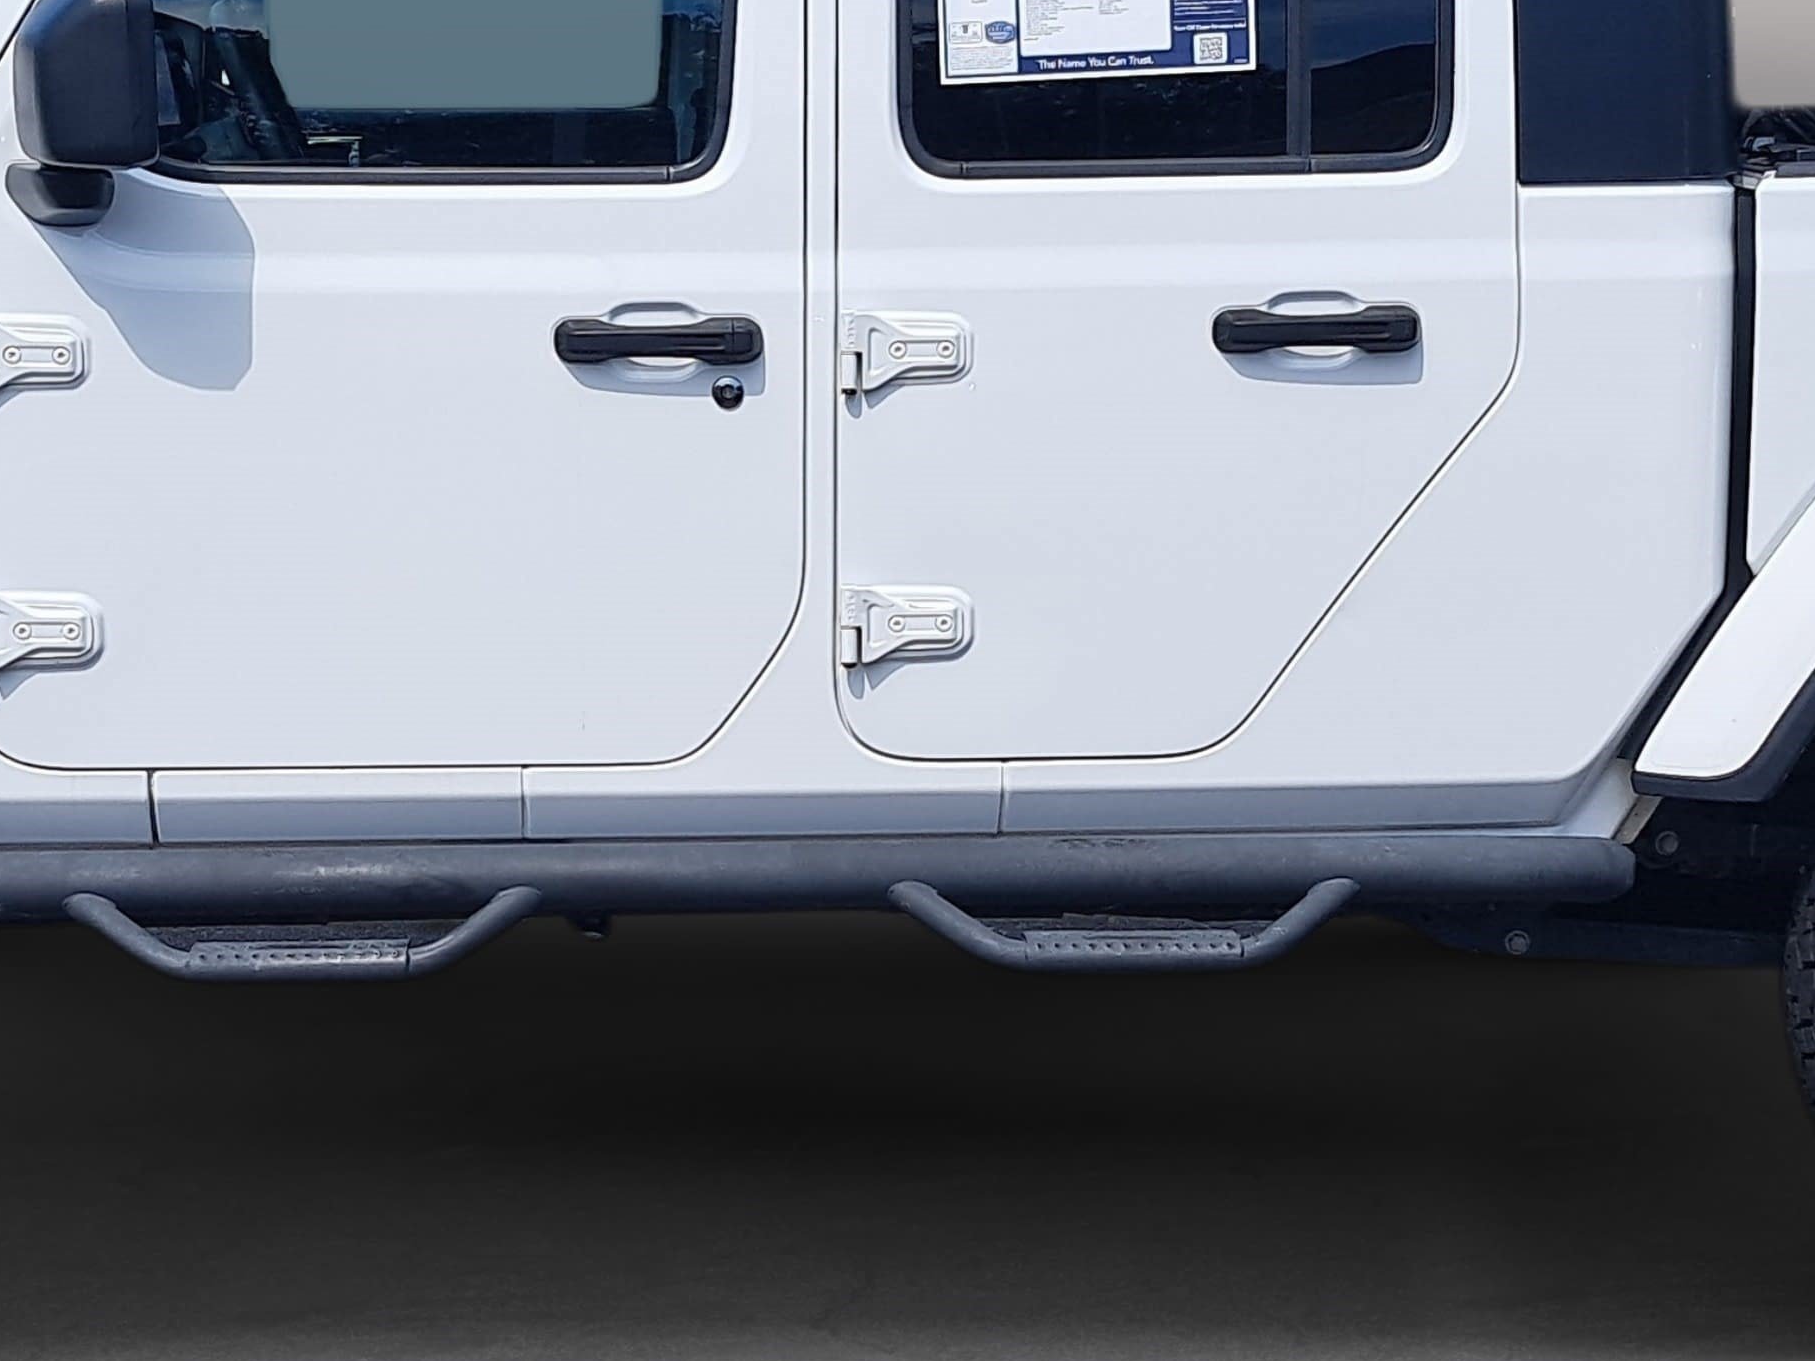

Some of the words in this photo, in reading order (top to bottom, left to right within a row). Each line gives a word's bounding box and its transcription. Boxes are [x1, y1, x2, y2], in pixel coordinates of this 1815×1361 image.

[1036, 59, 1056, 70] The
[1057, 58, 1086, 69] Name
[1087, 56, 1106, 67] You
[1107, 56, 1126, 66] Can
